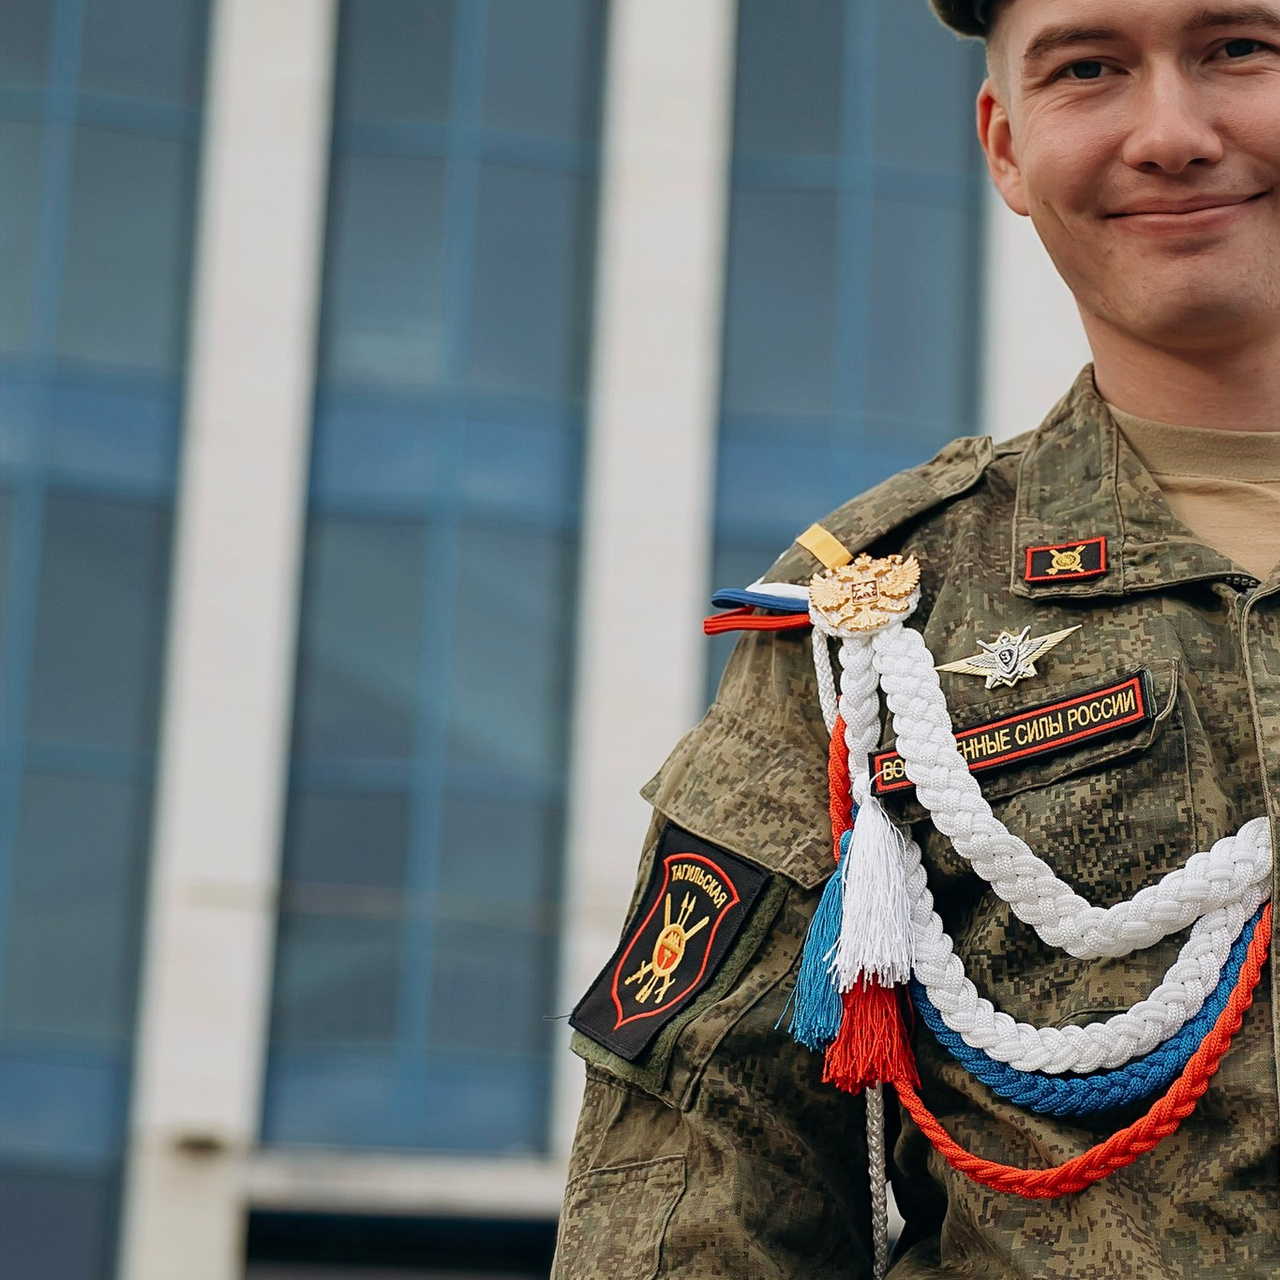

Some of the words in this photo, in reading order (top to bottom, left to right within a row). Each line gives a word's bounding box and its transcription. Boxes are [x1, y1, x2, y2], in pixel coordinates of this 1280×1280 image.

[1014, 712, 1063, 744] СИЛЫ
[1068, 689, 1135, 730] РОССИИ
[671, 864, 728, 908] ТАГИЛЬСКАЯ
